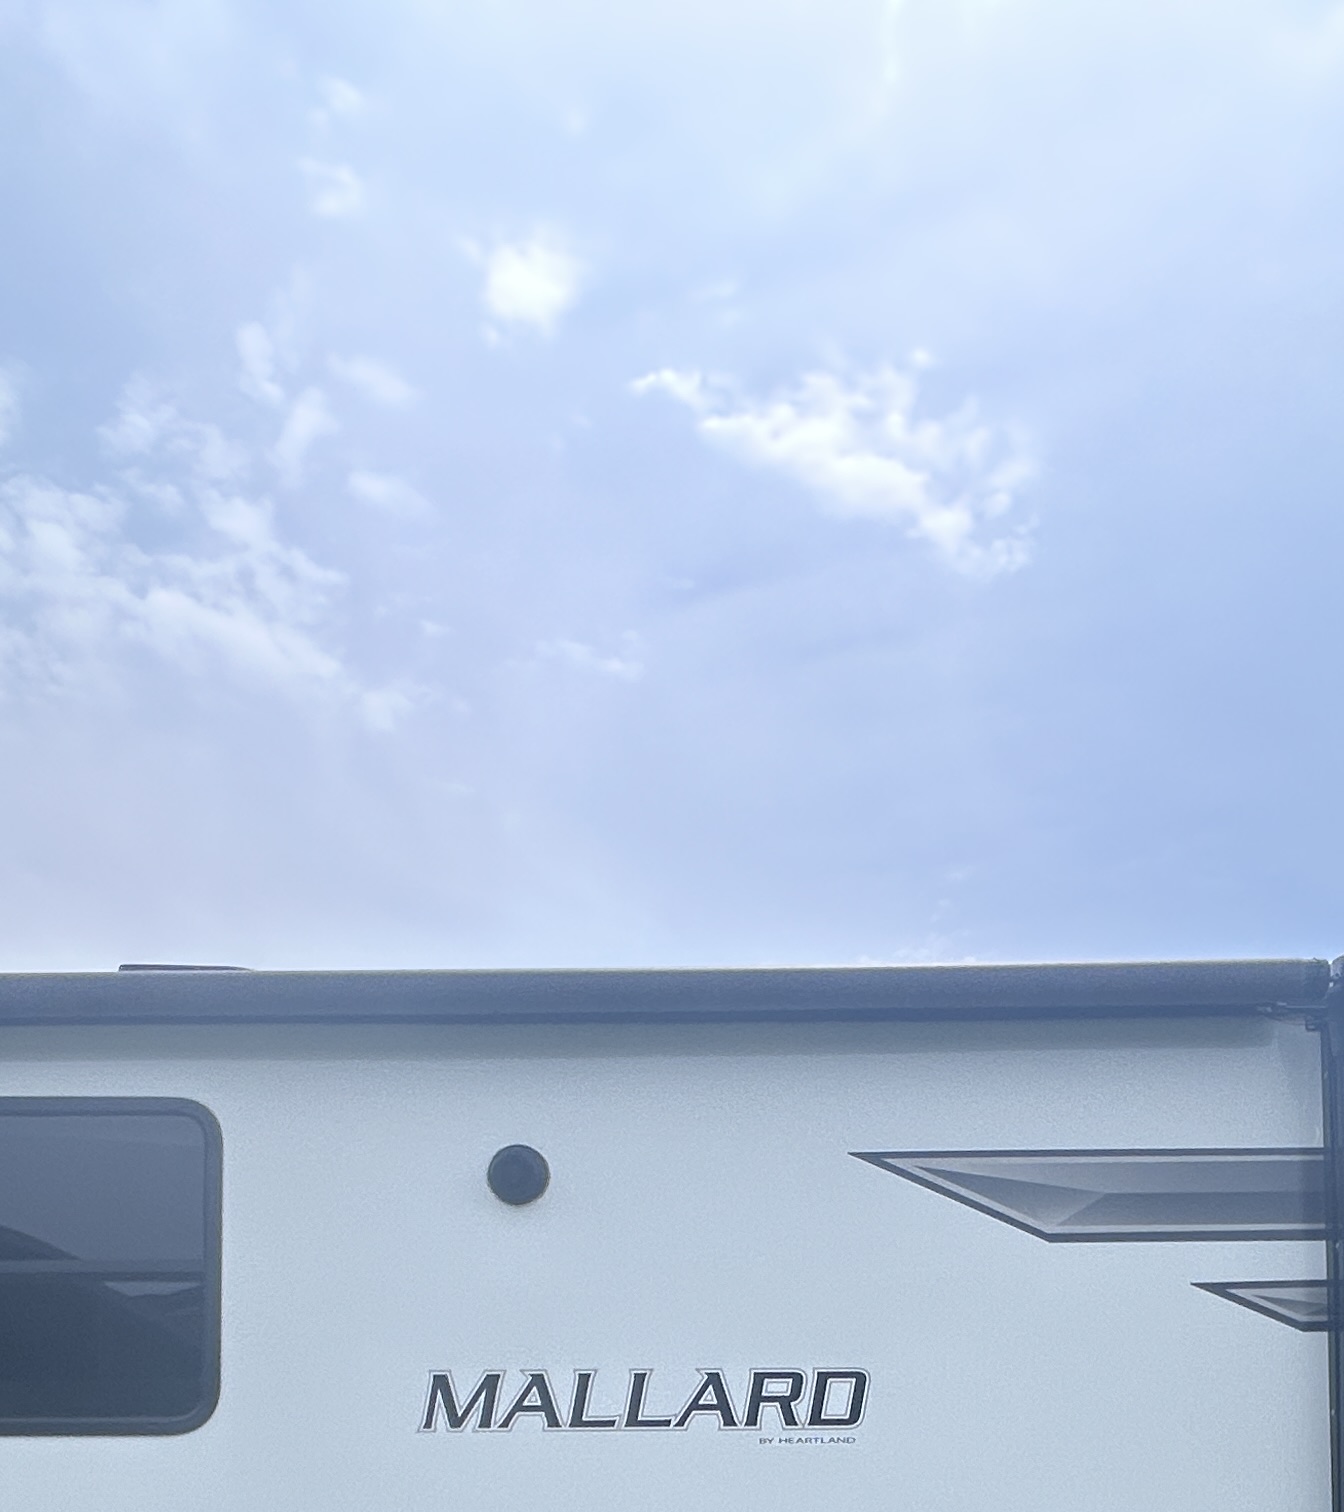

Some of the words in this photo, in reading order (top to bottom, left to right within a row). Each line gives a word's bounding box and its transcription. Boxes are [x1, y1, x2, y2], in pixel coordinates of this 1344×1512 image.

[418, 1368, 870, 1432] MALLARD
[759, 1437, 775, 1445] BY
[778, 1436, 857, 1445] HEARTLAND
